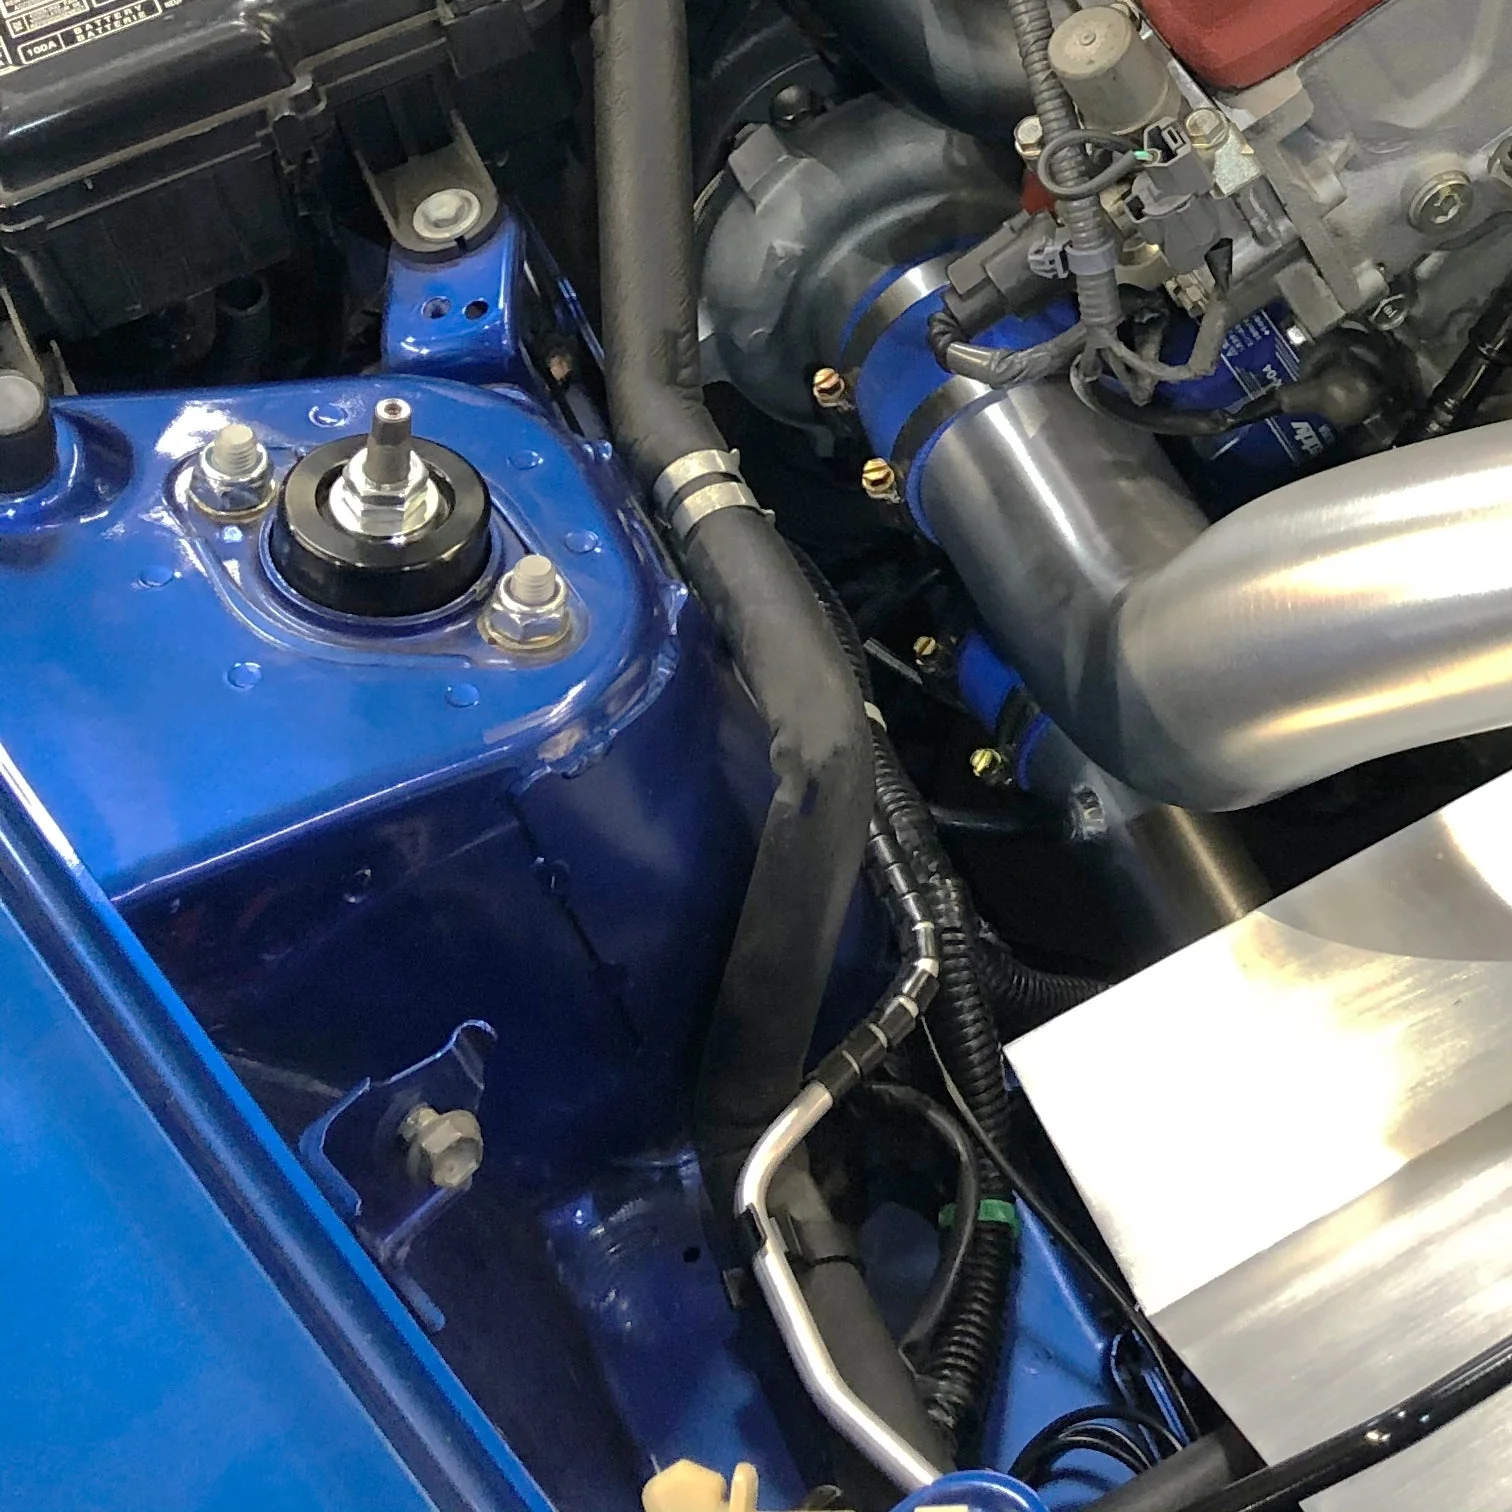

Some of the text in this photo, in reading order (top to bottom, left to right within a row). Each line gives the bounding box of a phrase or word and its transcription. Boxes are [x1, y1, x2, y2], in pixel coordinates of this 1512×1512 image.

[74, 4, 143, 34] BATTERY
[77, 11, 146, 41] BATTERIE
[27, 40, 57, 56] 100A
